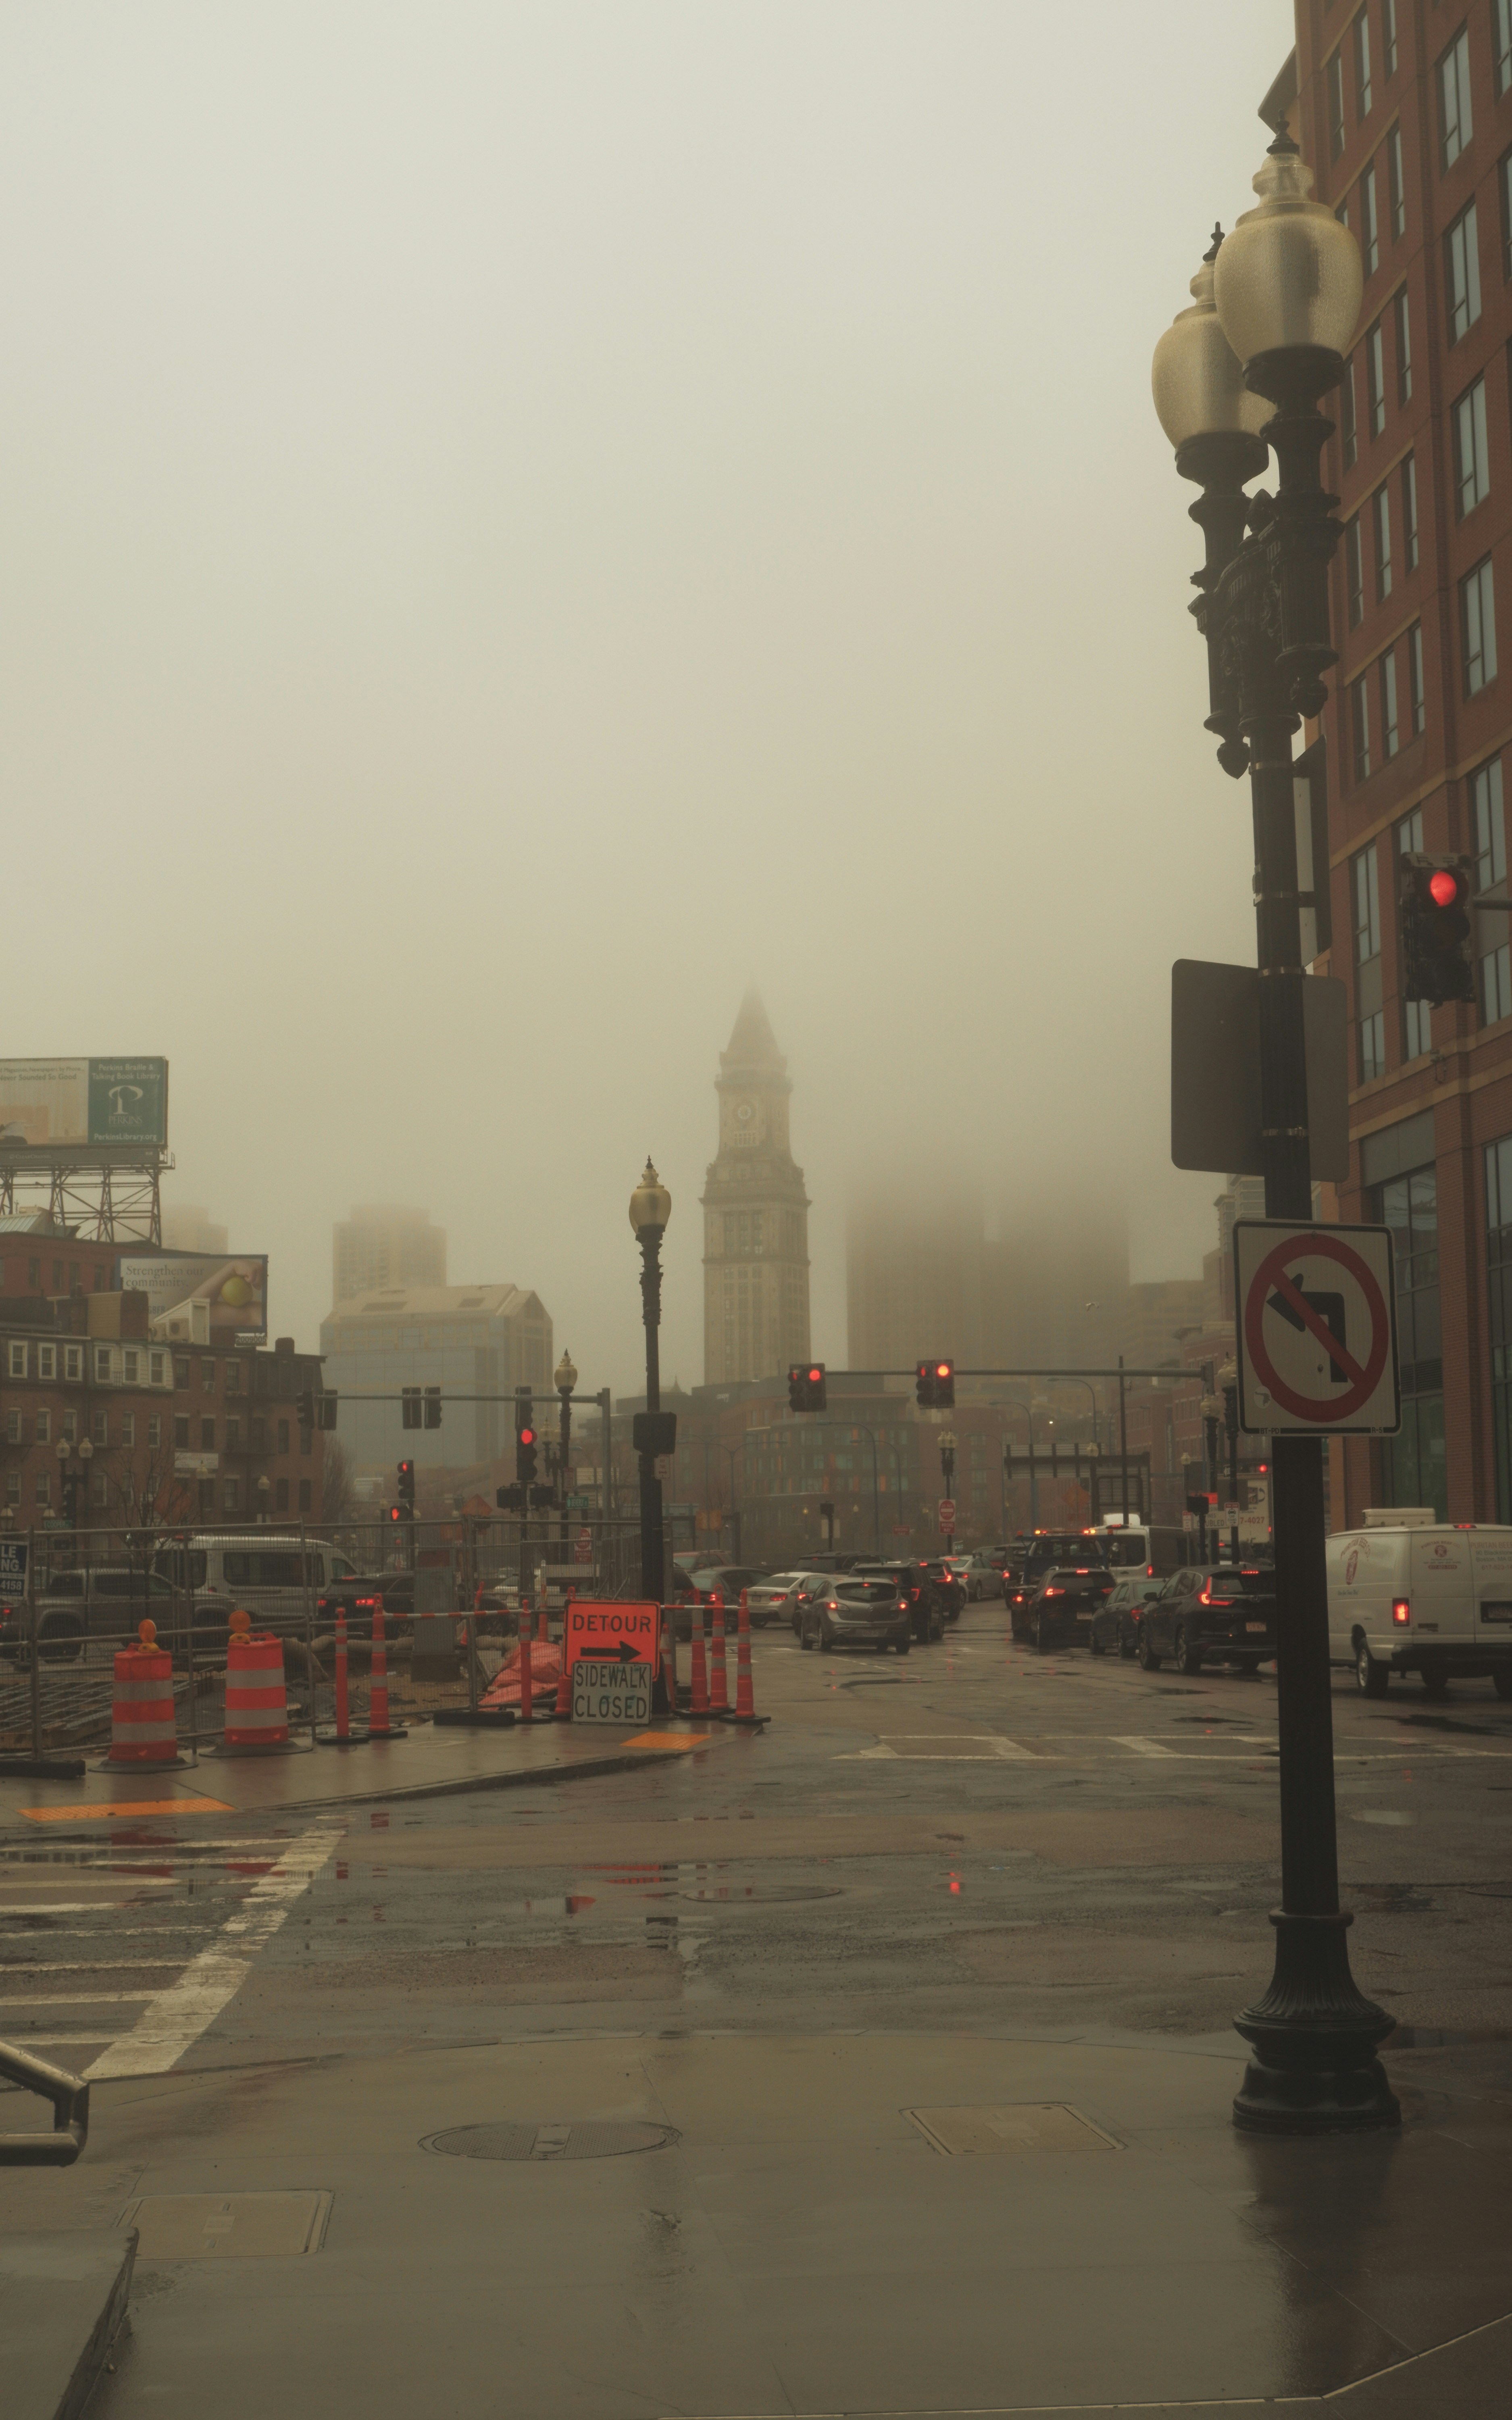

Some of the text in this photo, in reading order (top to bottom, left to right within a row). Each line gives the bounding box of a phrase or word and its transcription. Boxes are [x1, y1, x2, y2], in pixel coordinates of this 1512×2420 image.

[92, 1073, 115, 1081] Talking
[137, 1072, 160, 1081] Library
[108, 1116, 142, 1124] PERKINS
[94, 1133, 157, 1142] PerkinsLibrary.org
[126, 1265, 183, 1278] Strengthen
[126, 1277, 189, 1287] community.
[0, 1545, 17, 1558] LE
[0, 1559, 20, 1572] NG
[0, 1580, 22, 1590] 4158
[573, 1615, 651, 1633] DETOUR
[575, 1664, 647, 1689] SIDEWALK
[575, 1695, 646, 1719] CLOSED
